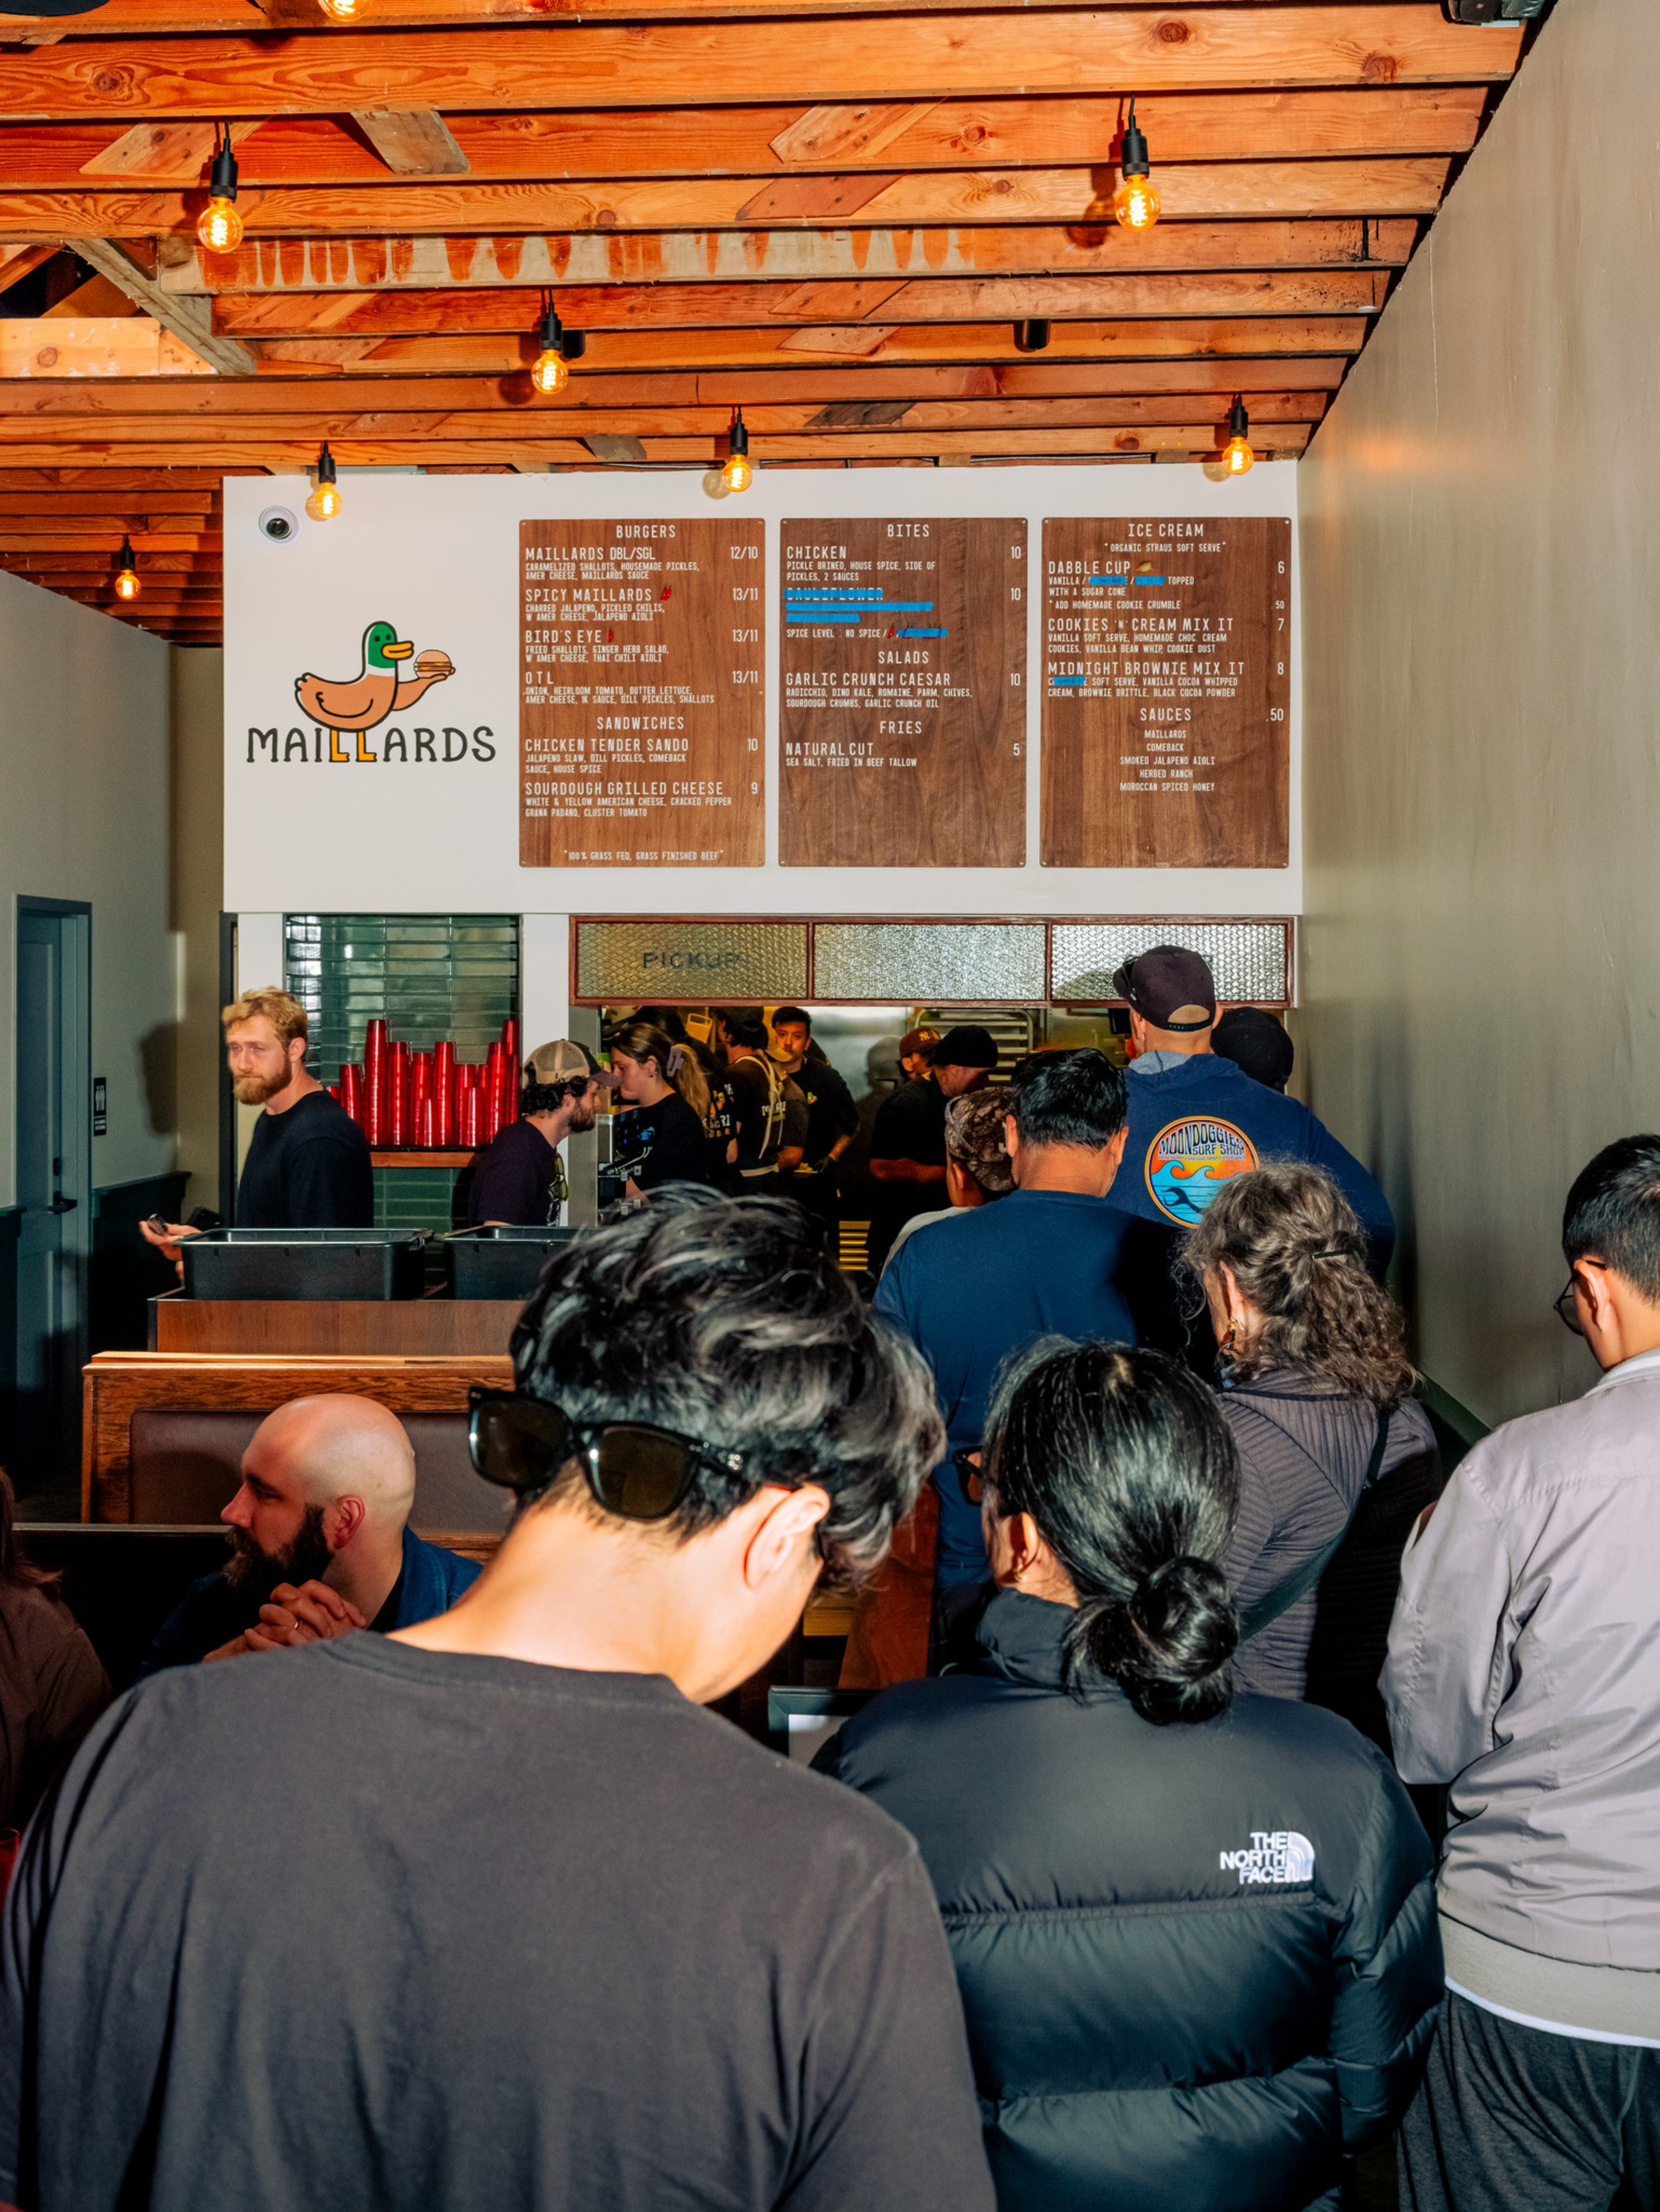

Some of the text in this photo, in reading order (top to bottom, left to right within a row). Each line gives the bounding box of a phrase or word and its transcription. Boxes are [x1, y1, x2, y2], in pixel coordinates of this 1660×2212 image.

[616, 525, 675, 538] BURGERS
[887, 524, 929, 537] BITES
[1128, 523, 1203, 537] ICE CREAM
[526, 546, 758, 561] MAILLARDS DBL/SGL 12/10
[787, 546, 1021, 559] CHICKEN 10
[621, 562, 662, 571] HOUSEMADE
[787, 561, 813, 570] PICKLE
[850, 561, 872, 570] HOUSE
[905, 561, 922, 570] SIDE
[926, 561, 935, 570] OF
[1049, 561, 1285, 574] DABBLE CUP 6
[526, 571, 545, 580] AMER
[582, 571, 623, 580] MAILLARDS
[627, 571, 649, 580] SAUCE
[824, 572, 829, 581] 2
[833, 572, 859, 581] SAUCES
[526, 587, 758, 602] SPICY MAILLARDS 13/11
[1011, 587, 1021, 600] 10
[1049, 587, 1126, 596] WITH A SUGAR CONE
[526, 604, 556, 612] CHARRED
[601, 604, 632, 613] PICKLED
[1055, 600, 1069, 609] ADD
[1073, 600, 1112, 609] HOMEMADE
[1117, 600, 1143, 609] COOKIE
[1147, 600, 1181, 609] CRUMBLE
[1048, 618, 1108, 631] COOKIES
[1132, 618, 1176, 631] CREAM
[1183, 618, 1209, 631] MIX
[1218, 618, 1233, 631] IT
[1278, 618, 1284, 631] 7
[525, 629, 758, 643] BIRD'S EYE 13/11
[1048, 633, 1079, 642] VANILLA
[1083, 633, 1101, 642] SOFT
[1134, 633, 1173, 642] HOMEMADE
[1203, 633, 1227, 642] CREAM
[526, 645, 548, 654] FRIED
[593, 645, 619, 654] GINGER
[623, 645, 641, 654] HERB
[1085, 644, 1117, 653] VANILLA
[1120, 644, 1139, 653] BEAN
[1167, 644, 1193, 653] COOKIE
[1198, 644, 1215, 653] DUST
[878, 651, 929, 664] SALADS
[1048, 662, 1284, 675] MIDNIGHT BROWNIE MIX IT 8
[732, 670, 758, 683] 13/11
[786, 673, 1020, 686] GARLIC CRUNCH CAESAR 10
[1092, 677, 1110, 686] SOFT
[1143, 677, 1174, 686] VANILLA
[1178, 677, 1200, 686] COCOA
[1204, 677, 1238, 686] WHIPPED
[832, 688, 850, 697] DINO
[1079, 688, 1111, 697] BROWNIE
[1153, 688, 1175, 697] BLACK
[1180, 688, 1202, 697] COCOA
[1207, 688, 1235, 697] POWDER
[786, 699, 826, 708] SOURDOUGH
[865, 699, 891, 708] GARLIC
[895, 699, 922, 708] CRUNCH
[926, 699, 939, 708] OIL
[1140, 708, 1191, 721] SAUCES
[597, 716, 684, 730] SANDWICHES
[880, 720, 921, 734] FRIES
[1144, 730, 1187, 739] MAILLARDS
[246, 726, 496, 762] MAILLARDS
[525, 738, 758, 752] CHICKEN TENDER SANDO 10
[786, 743, 1020, 756] NATURAL CUT 5
[1147, 743, 1184, 752] COMEBACK
[526, 754, 561, 762] JALAPENO
[590, 753, 608, 762] DILL
[649, 753, 686, 762] COMEBACK
[786, 757, 799, 766] SEA
[827, 757, 849, 767] FRIED
[854, 758, 863, 767] IN
[866, 758, 884, 767] BEEF
[889, 758, 917, 767] TALLOW
[1120, 756, 1215, 765] SMOKED JALAPENO AIOLI
[1140, 769, 1193, 778] HERBED RANCH
[525, 781, 758, 795] SOURDOUGH GRILLED CHEESE 9
[1120, 782, 1215, 791] MOROCCAN SPICED HONEY
[642, 951, 740, 969] PICKUP
[1159, 1122, 1245, 1155] MOONDOGGIES
[1192, 1143, 1246, 1155] SURF SHOP
[1250, 1832, 1288, 1850] THE
[1219, 1850, 1286, 1870] NORTH
[1239, 1866, 1286, 1885] FACE
